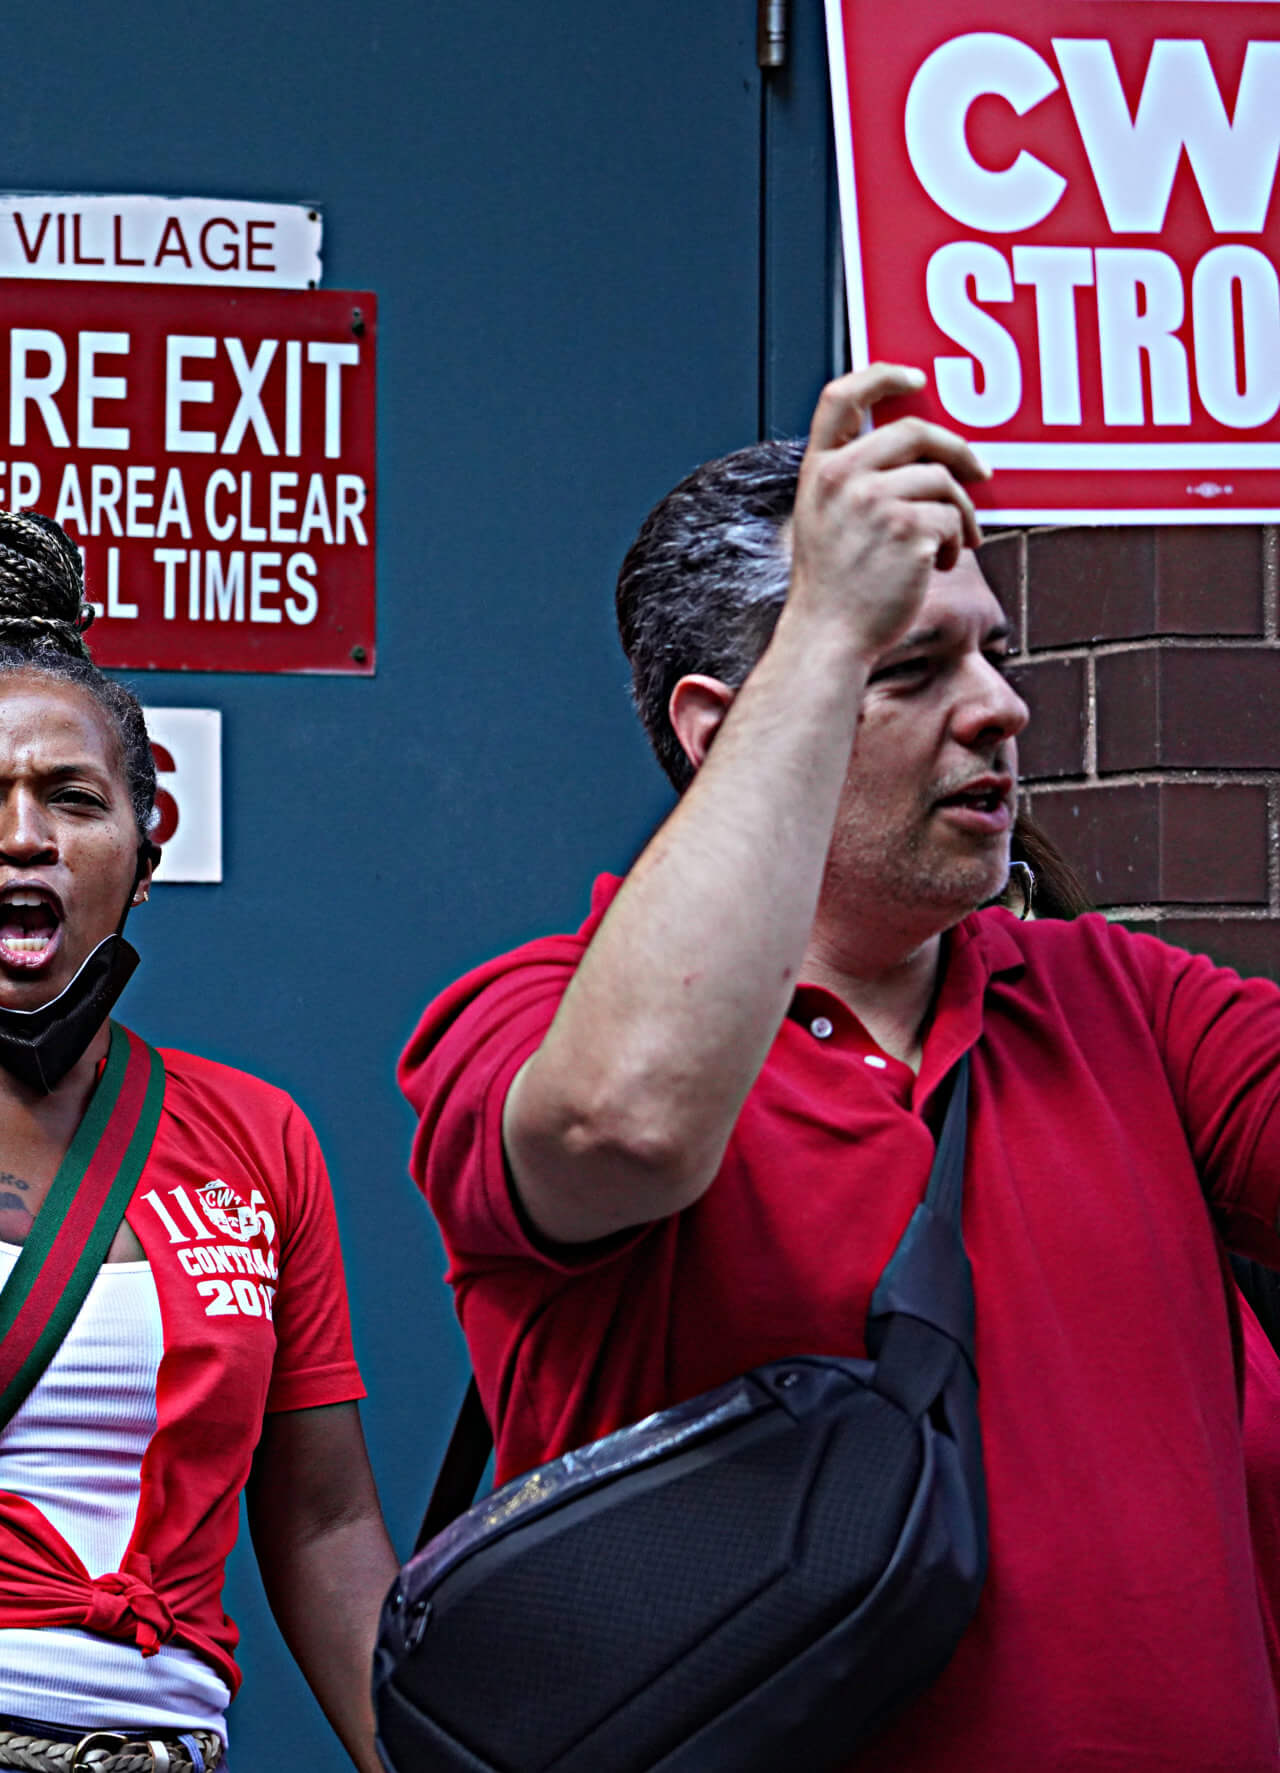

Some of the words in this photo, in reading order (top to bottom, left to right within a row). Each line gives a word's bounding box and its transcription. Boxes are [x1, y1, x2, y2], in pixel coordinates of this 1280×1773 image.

[13, 212, 276, 271] VILLAGE
[926, 241, 1280, 428] STRO
[165, 335, 359, 459] EXIT
[54, 463, 192, 538] AREA
[205, 468, 368, 545] CLEAR
[153, 548, 318, 624] TIMES
